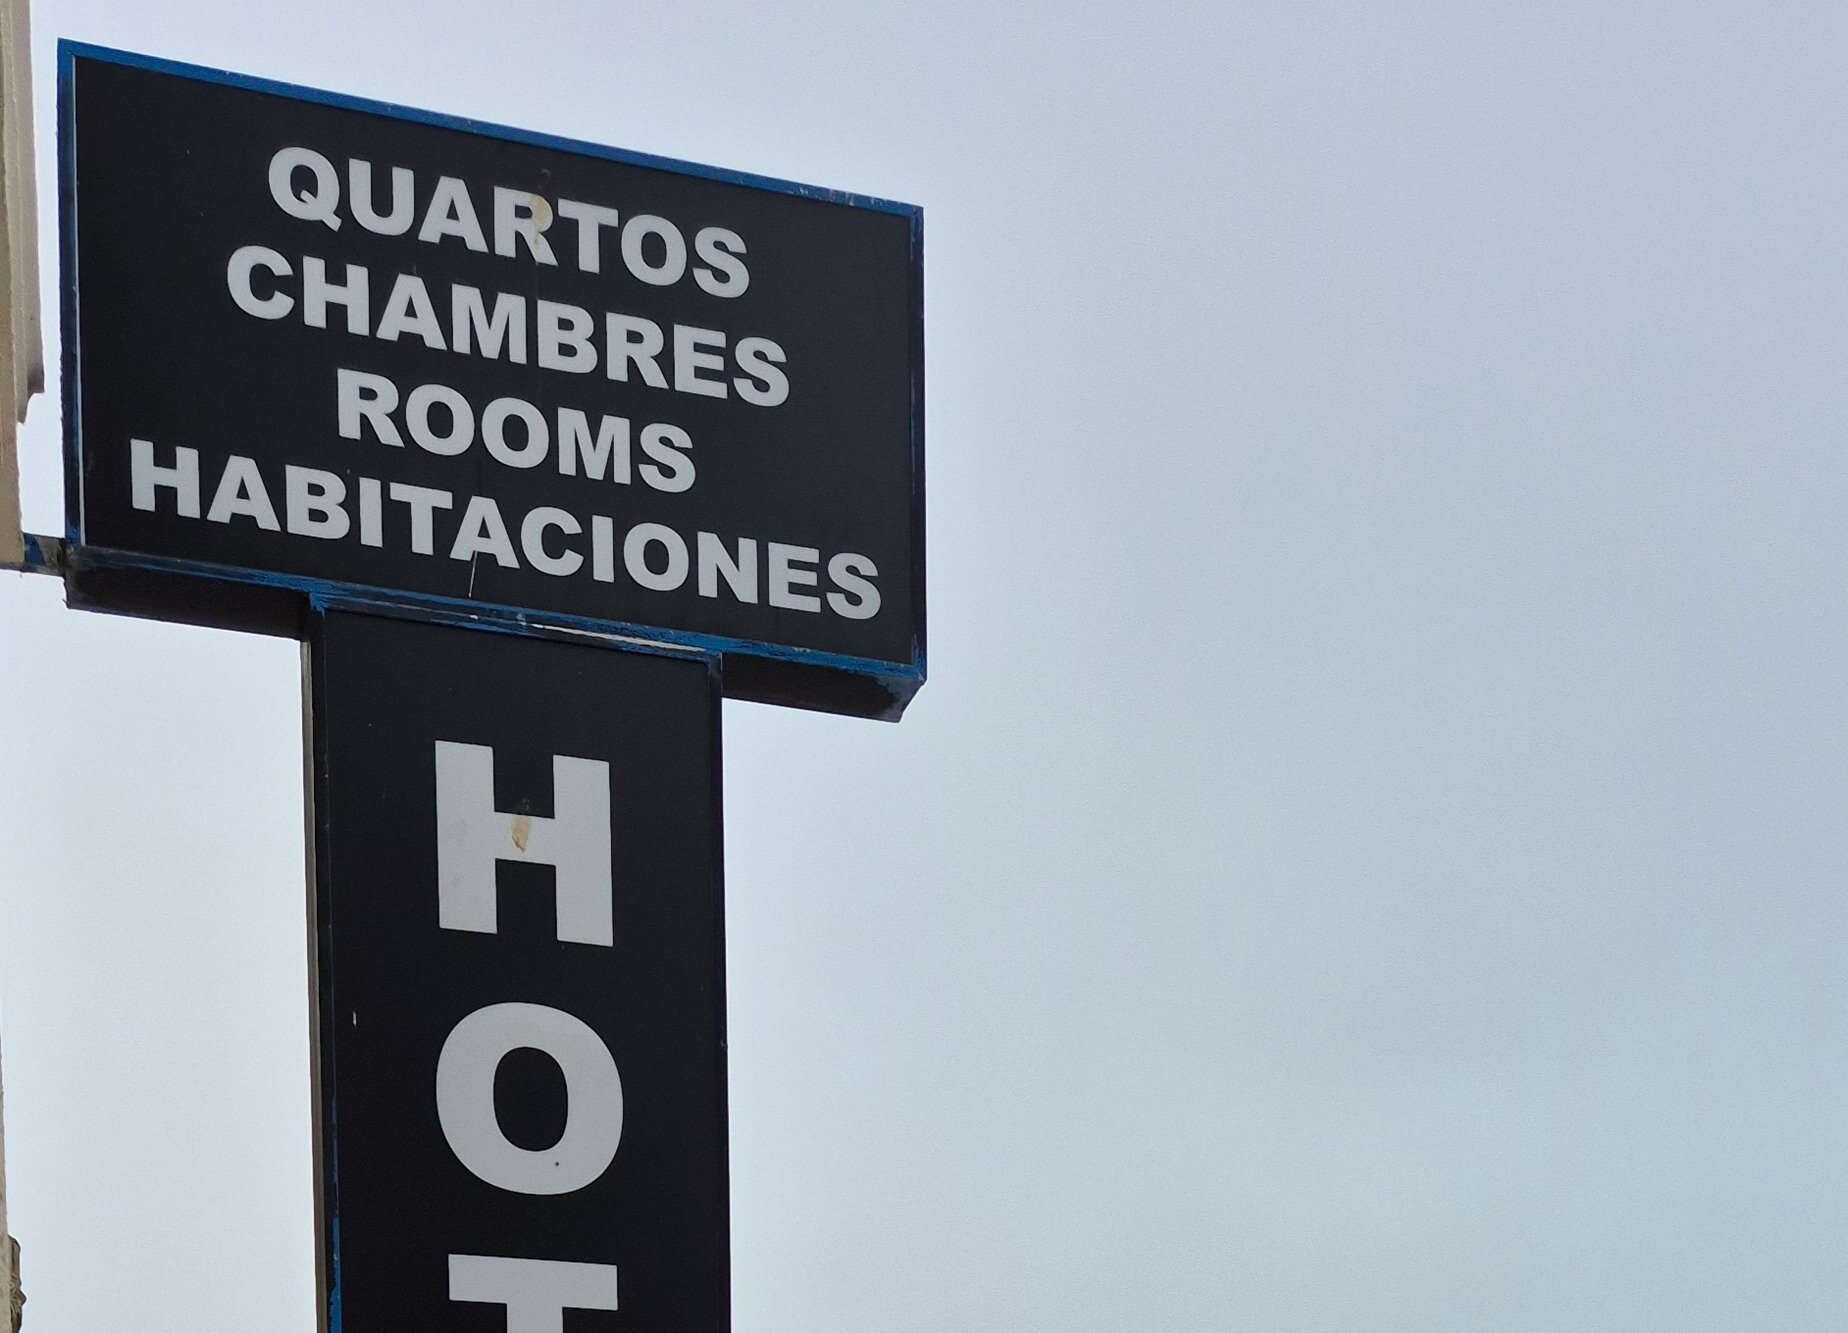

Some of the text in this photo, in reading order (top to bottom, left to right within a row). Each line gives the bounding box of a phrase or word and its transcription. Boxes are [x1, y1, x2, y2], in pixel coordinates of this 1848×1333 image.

[268, 146, 750, 298] QUARTOS
[227, 245, 789, 407] CHAMBRES
[337, 368, 696, 493] ROOMS
[130, 438, 881, 620] HABITACIONES
